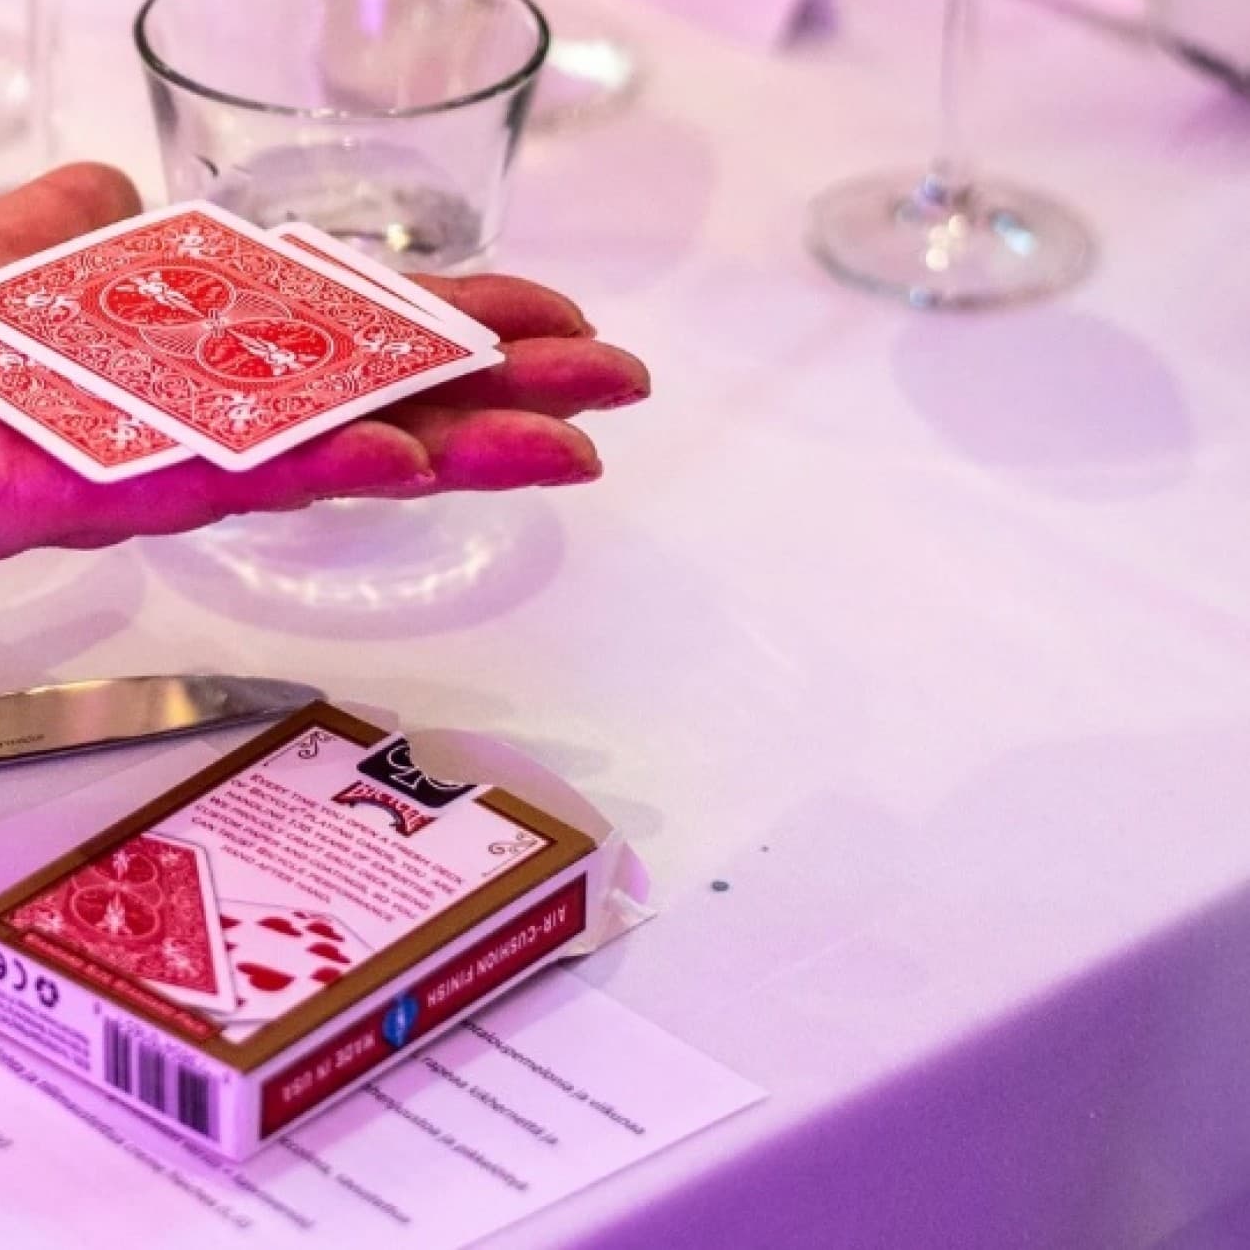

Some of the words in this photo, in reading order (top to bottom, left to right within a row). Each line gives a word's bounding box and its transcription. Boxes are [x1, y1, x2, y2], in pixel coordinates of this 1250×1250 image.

[343, 818, 378, 838] OPEN
[476, 903, 568, 973] AIR-CUSHION
[426, 964, 474, 1007] FINISH
